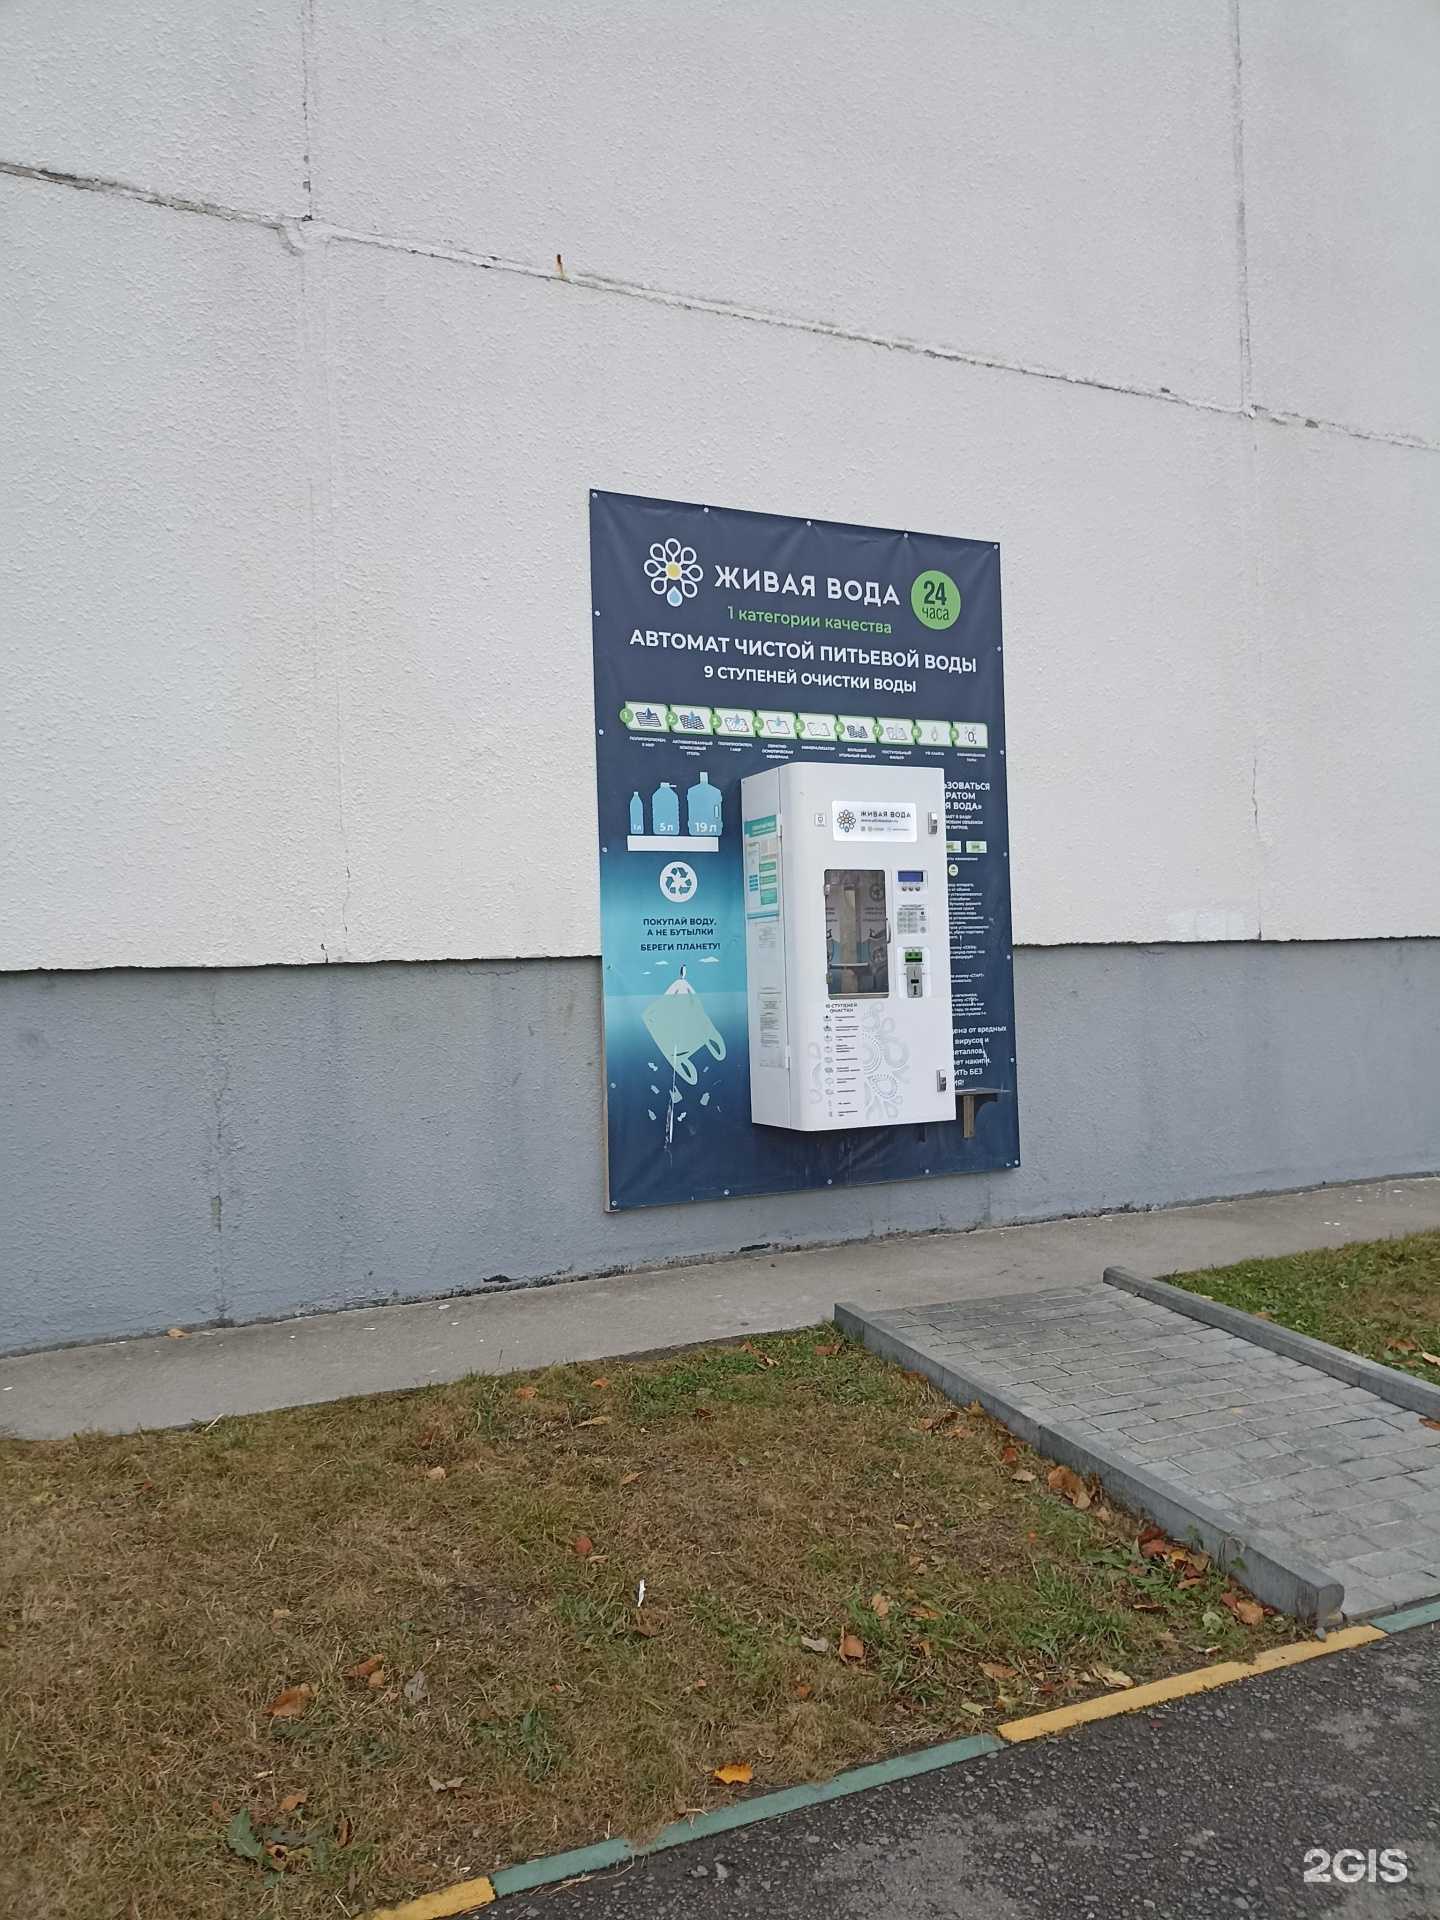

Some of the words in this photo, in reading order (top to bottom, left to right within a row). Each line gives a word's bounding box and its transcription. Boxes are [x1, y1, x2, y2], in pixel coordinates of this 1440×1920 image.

[714, 564, 816, 598] ЖИВАЯ
[827, 577, 900, 607] ВОДА
[923, 580, 947, 606] 24
[921, 607, 949, 621] часа
[727, 605, 734, 620] 1
[738, 609, 821, 628] категории
[825, 616, 892, 634] качества
[629, 628, 730, 654] АВТОМАТ
[734, 636, 815, 661] ЧИСТОЙ
[820, 645, 919, 669] ПИТЬЕВОЙ
[925, 655, 977, 673] ВОДЫ
[704, 665, 714, 680] 9
[717, 665, 798, 685] СТУПЕНЕЙ
[801, 672, 870, 689] ОЧИСТКИ
[873, 678, 917, 694] ВОДЫ
[945, 791, 976, 800] РАТОМ
[860, 810, 888, 818] ЖИВАЯ
[890, 811, 911, 819] ВОДА
[695, 822, 707, 832] 19
[643, 917, 687, 926] ПОКУПАЙ
[670, 928, 713, 936] БУТЫЛКИ
[640, 943, 674, 951] БЕРЕГИ
[676, 942, 720, 951] ПЛАНЕТУ!
[970, 1067, 983, 1075] БЕЗ
